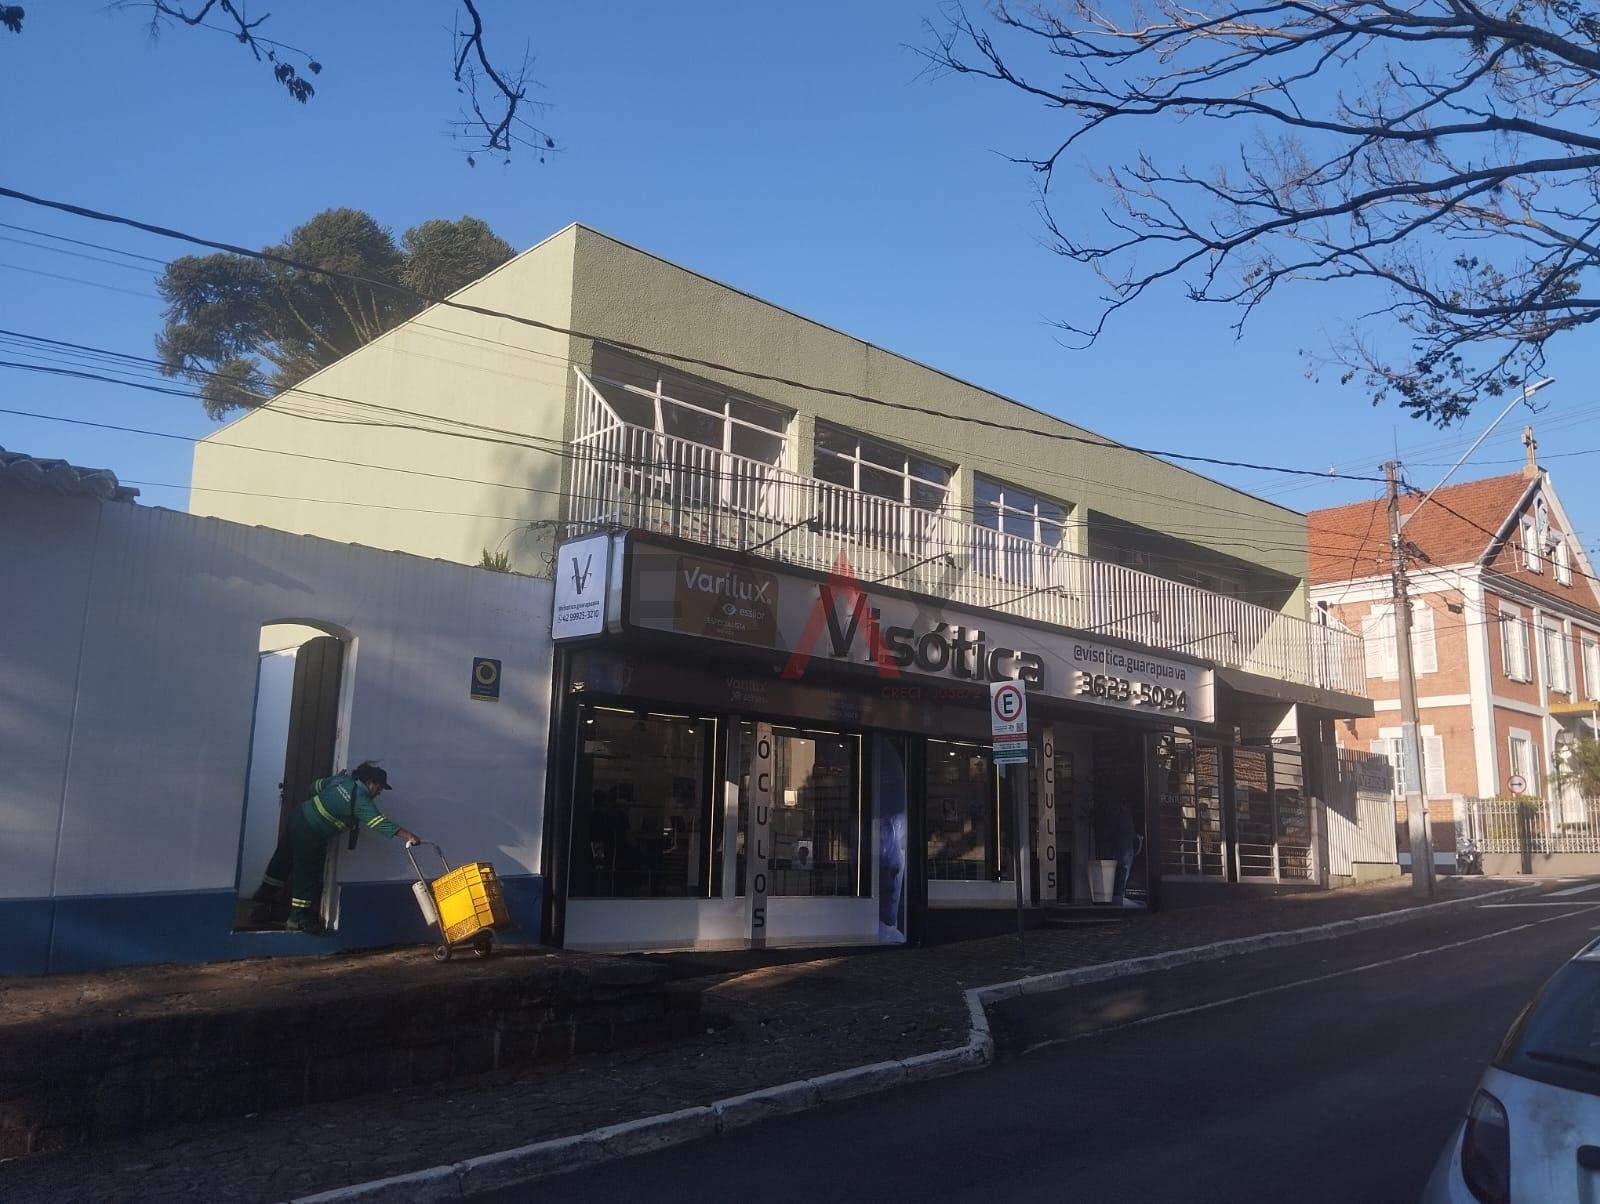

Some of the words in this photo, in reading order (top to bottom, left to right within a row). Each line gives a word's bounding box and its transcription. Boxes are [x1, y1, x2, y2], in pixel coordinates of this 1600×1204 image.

[684, 566, 771, 604] Varilux
[817, 584, 1045, 690] Visótica
[1074, 645, 1186, 680] @visotica.guarapuava
[1003, 693, 1014, 714] E
[1079, 671, 1187, 712] 3623-5094
